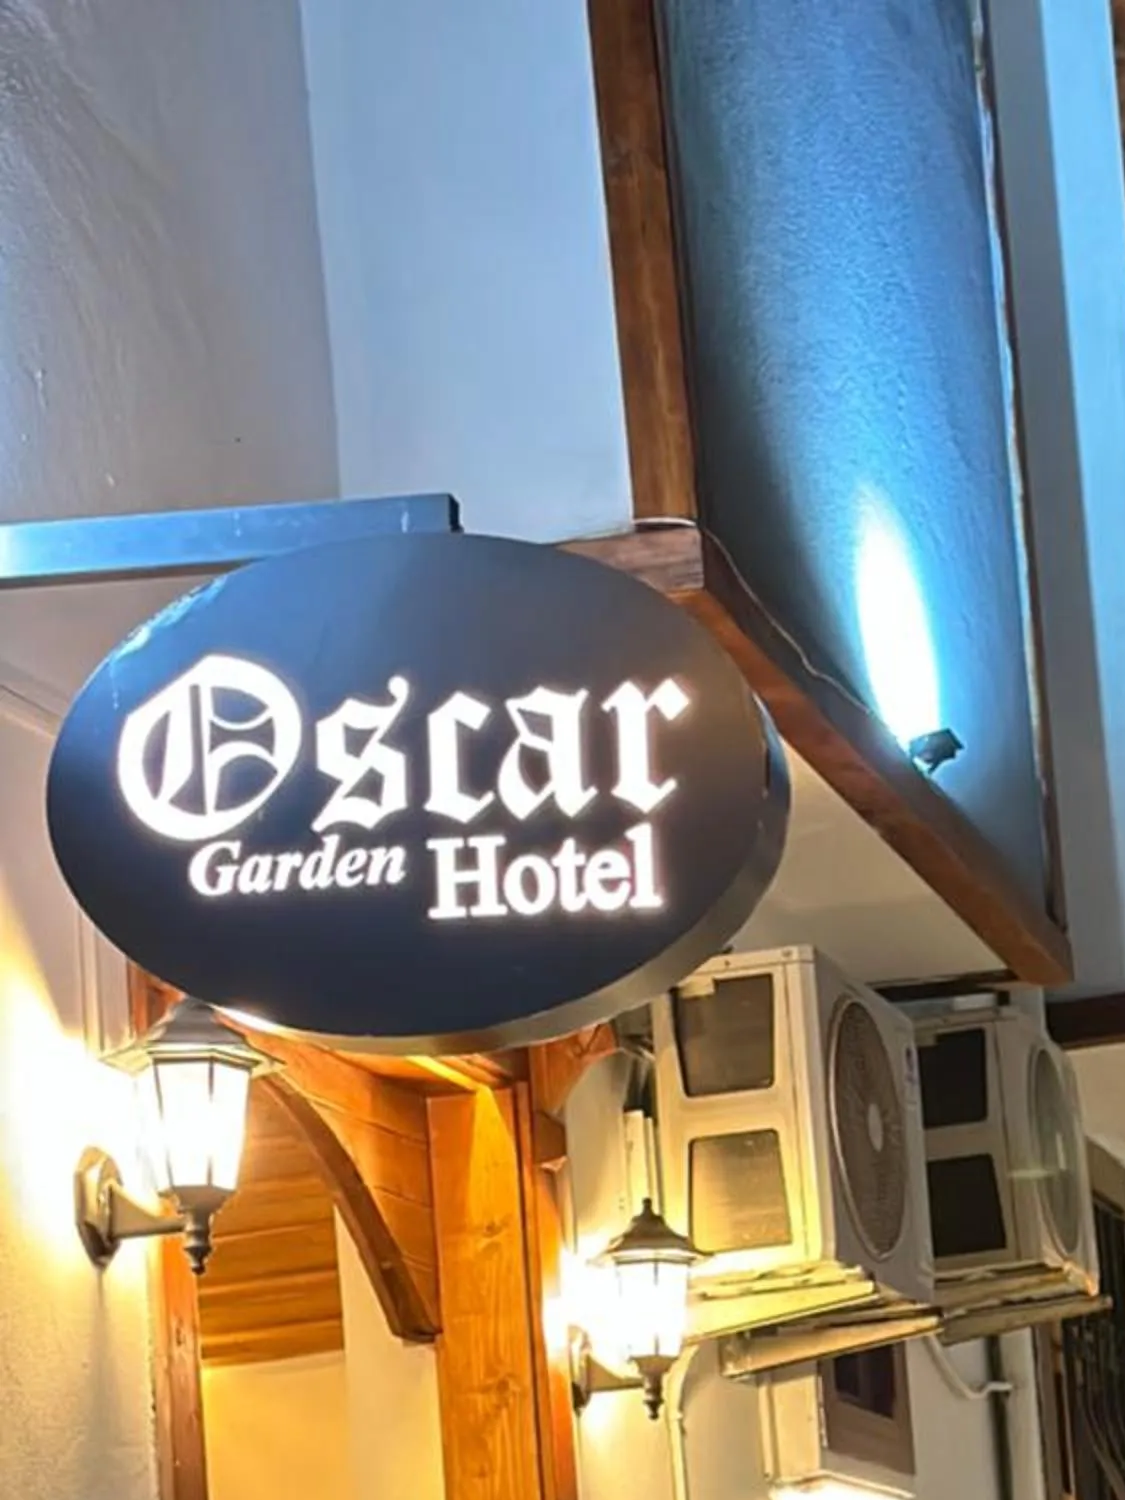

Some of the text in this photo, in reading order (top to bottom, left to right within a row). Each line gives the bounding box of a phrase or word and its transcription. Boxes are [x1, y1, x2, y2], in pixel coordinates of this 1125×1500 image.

[117, 654, 690, 841] Oscar
[189, 822, 663, 919] Garden Hotel
